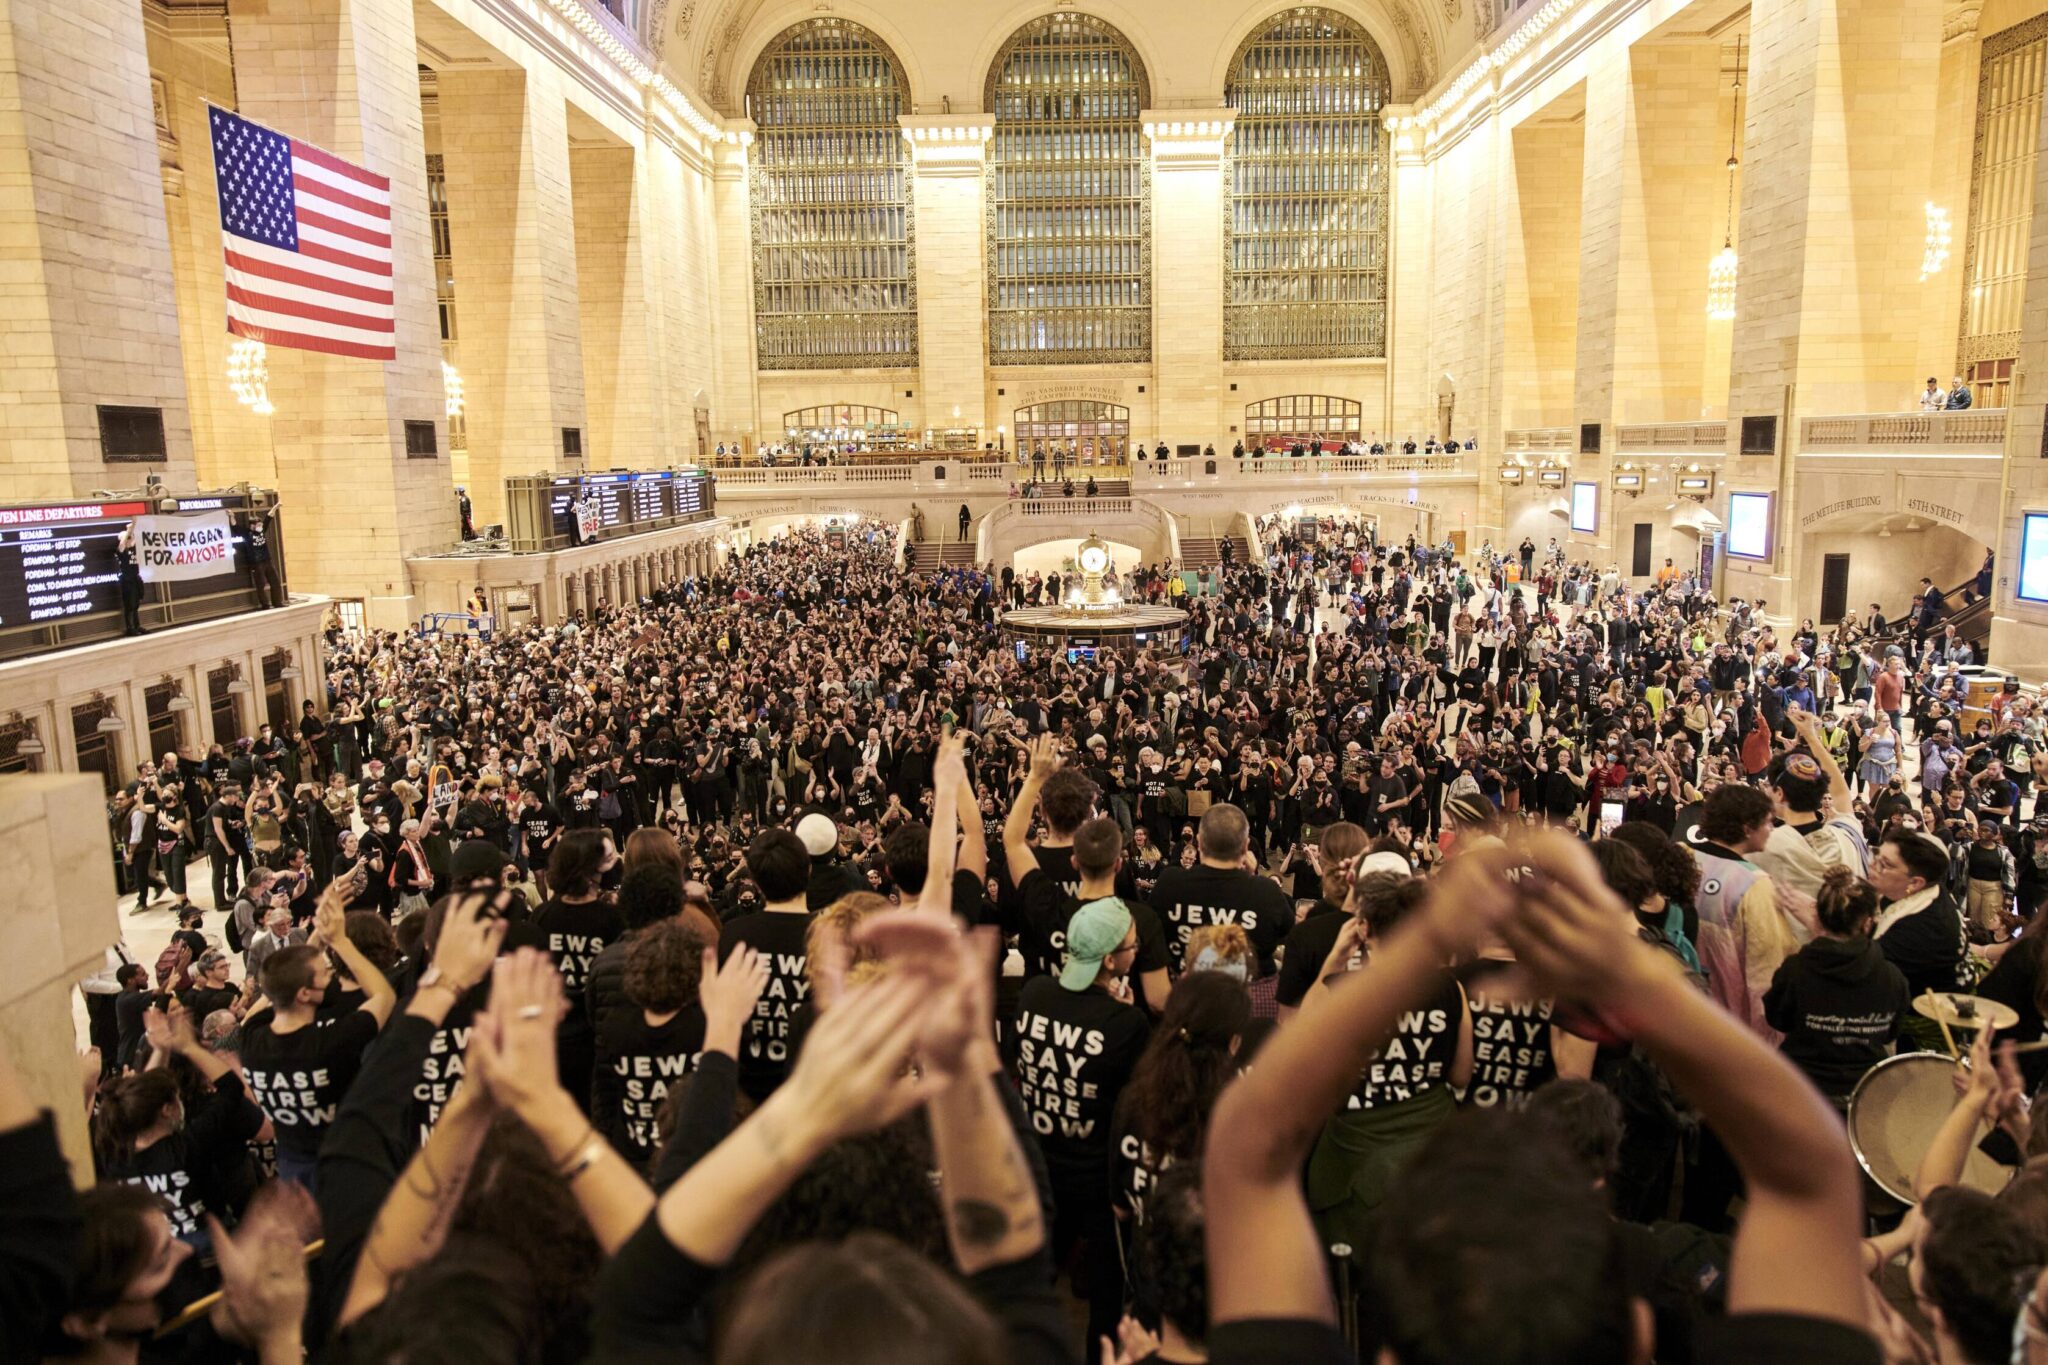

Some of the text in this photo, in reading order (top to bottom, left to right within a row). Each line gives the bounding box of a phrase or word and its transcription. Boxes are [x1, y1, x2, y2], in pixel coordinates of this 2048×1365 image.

[1038, 391, 1075, 401] CAMPBELL
[1080, 392, 1122, 403] APARTMENT
[1039, 385, 1084, 394] VANDERBILT
[1088, 384, 1117, 395] AVENUE
[179, 499, 222, 511] INFORMATION
[819, 505, 847, 513] SUBWAY
[1299, 495, 1335, 505] MACHINES
[1359, 494, 1386, 502] TRACKS
[19, 509, 43, 522] LINE
[44, 506, 103, 520] DEPARTURES
[732, 505, 796, 521] ICKET MACHINES
[1802, 495, 1881, 527] THE METLIFE BUILDING
[1907, 498, 1965, 524] 45TH STREET
[142, 531, 186, 547] NEVER
[144, 550, 175, 566] FOR
[176, 543, 226, 565] ANYONE
[432, 781, 458, 798] LAND
[1504, 865, 1536, 884] WS
[1168, 903, 1258, 930] JEWS
[549, 933, 604, 953] EWS
[559, 957, 593, 973] AY
[761, 953, 807, 976] EW
[766, 979, 811, 1000] AY
[1397, 1008, 1448, 1034] WS
[1474, 1016, 1543, 1045] SAY
[1016, 1010, 1106, 1056] JEWS
[1020, 1038, 1087, 1079] SAY
[1384, 1037, 1434, 1061] AY
[1476, 1042, 1547, 1068] EASE
[422, 1053, 466, 1081] SA
[1370, 1061, 1443, 1084] EASE
[1016, 1057, 1098, 1100] CEASE
[626, 1079, 669, 1101] SA
[1022, 1080, 1081, 1119] FIRE
